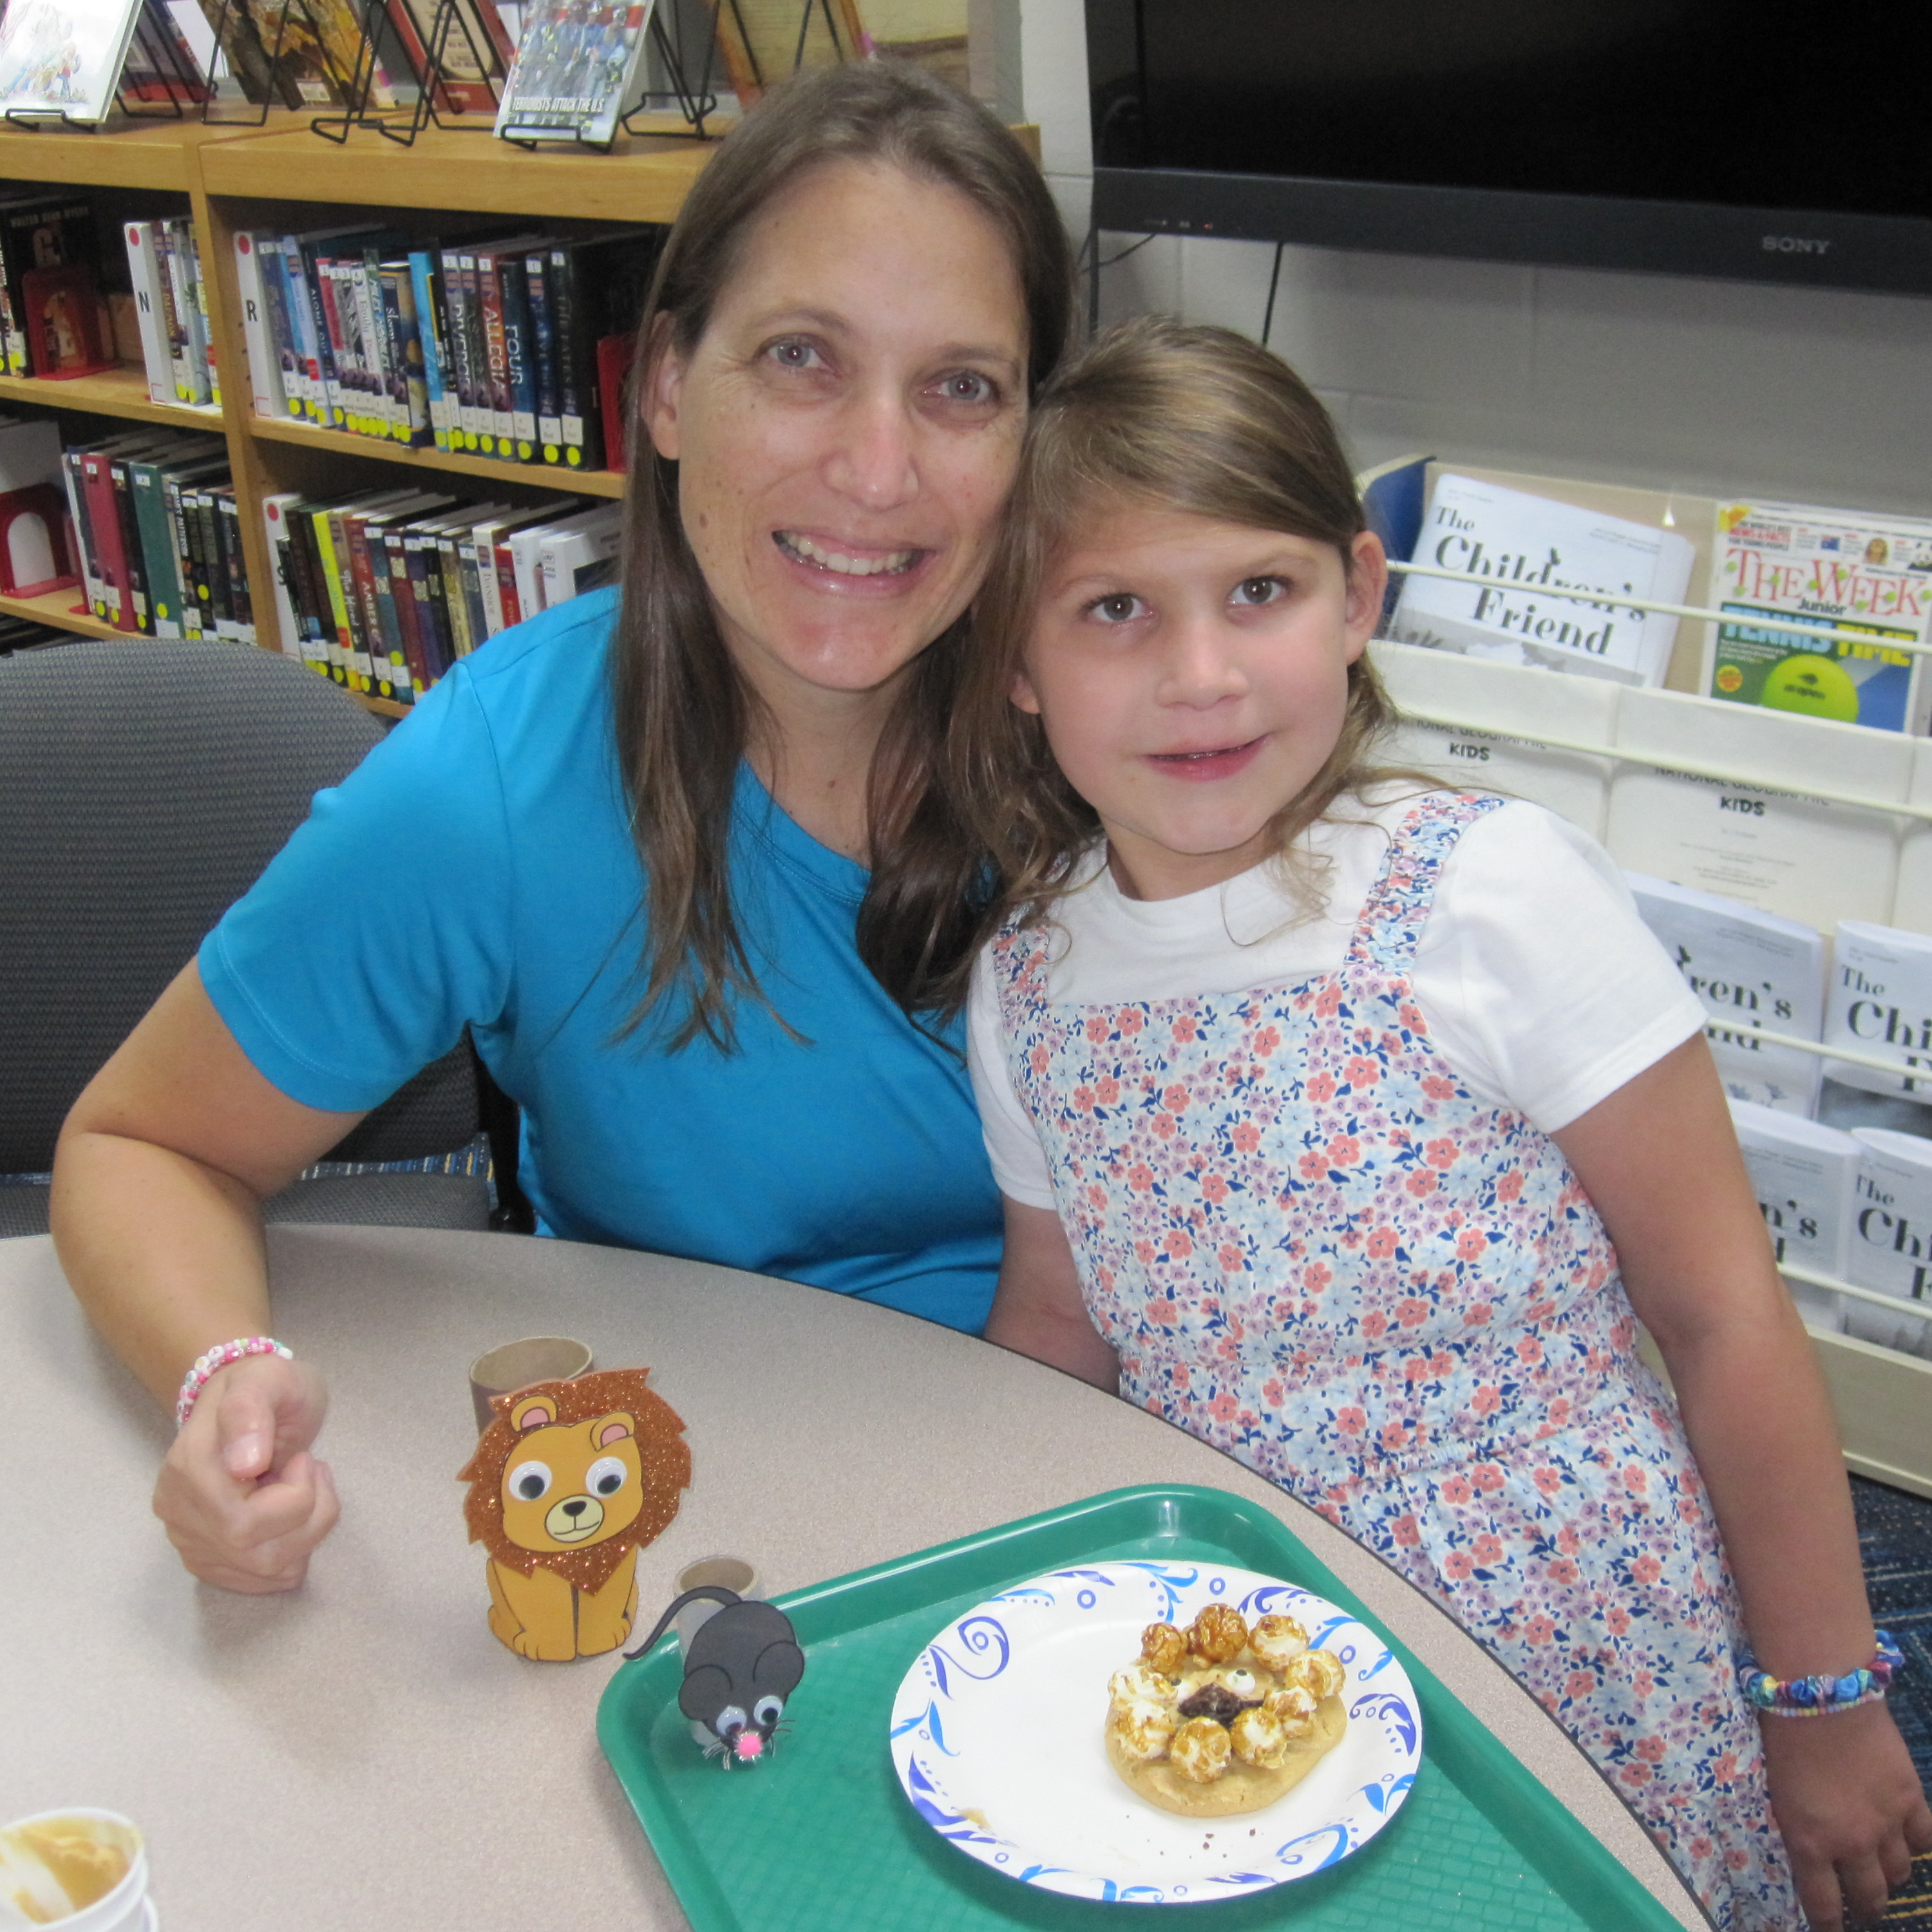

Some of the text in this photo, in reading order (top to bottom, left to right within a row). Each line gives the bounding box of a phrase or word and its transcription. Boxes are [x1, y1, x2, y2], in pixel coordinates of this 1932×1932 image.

[513, 97, 552, 111] TERRORISTS
[551, 97, 577, 111] ATTACK
[578, 98, 592, 112] THE
[1763, 236, 1831, 254] SONY
[138, 290, 150, 312] N
[245, 299, 257, 321] R
[504, 325, 523, 384] FOUR
[1435, 506, 1475, 531] The
[1726, 548, 1927, 616] THE WEEK
[363, 582, 377, 625] AMBER
[1797, 597, 1847, 616] Junior
[1471, 587, 1615, 655] Friend
[1723, 605, 1833, 653] TENNIS
[1836, 623, 1915, 667] TIME
[1449, 742, 1491, 761] KIDS
[1719, 795, 1766, 817] KIDS
[1842, 964, 1886, 996] The
[1848, 999, 1932, 1050] Chi
[1856, 1173, 1895, 1206] The
